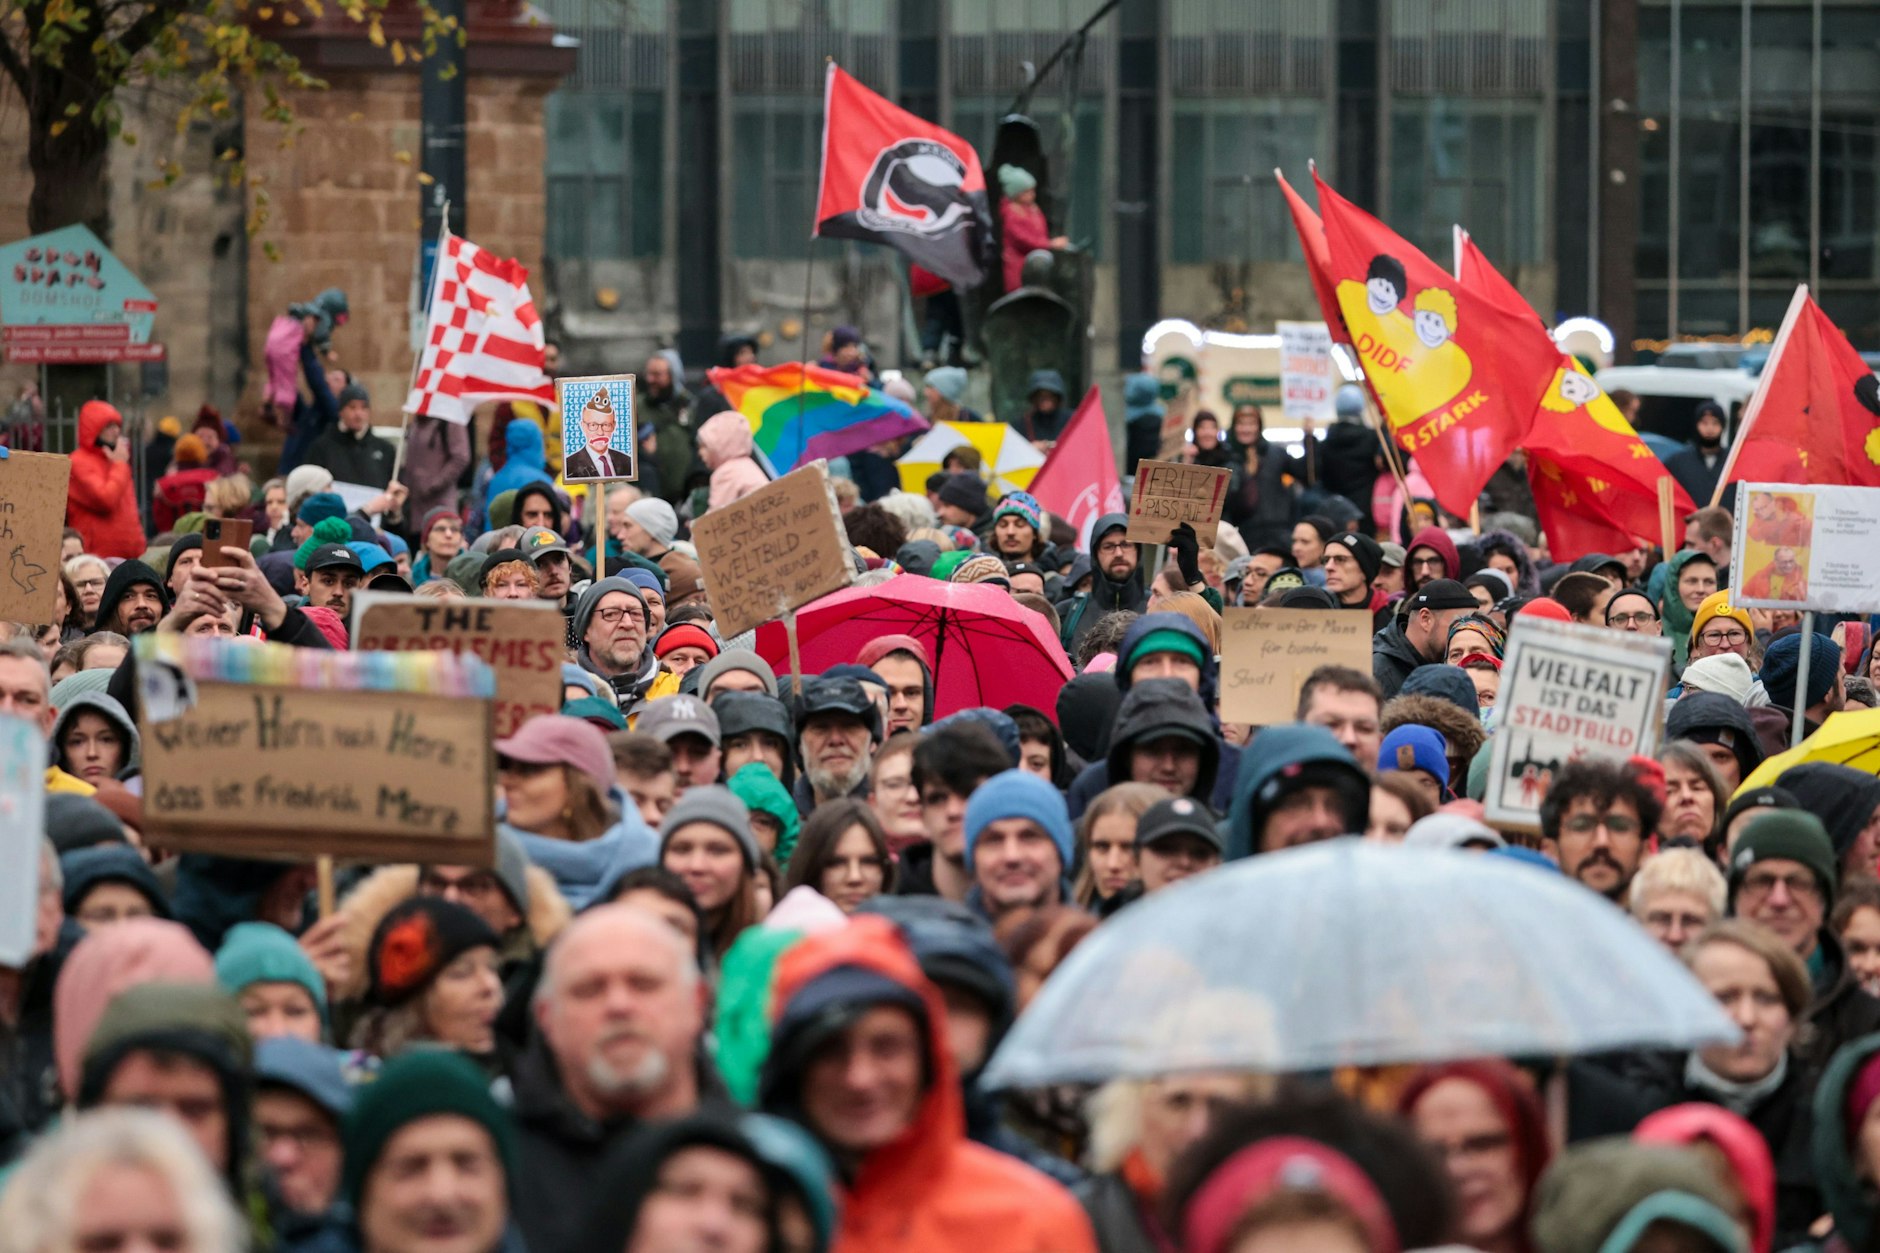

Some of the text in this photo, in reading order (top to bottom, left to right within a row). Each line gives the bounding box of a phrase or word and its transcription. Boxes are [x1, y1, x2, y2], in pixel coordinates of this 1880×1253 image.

[1357, 333, 1414, 374] DIDF
[1418, 389, 1489, 447] STARK
[1148, 467, 1211, 499] FRITZ
[712, 510, 745, 538] HERR
[731, 514, 788, 550] STÖREN
[793, 503, 820, 524] MEIN
[1143, 499, 1205, 521] PASS AUF
[712, 533, 800, 588] WELTBILD
[718, 586, 742, 605] UND
[722, 584, 786, 625] TOCHTER
[414, 606, 496, 632] THE
[1529, 655, 1643, 700] VIELFALT
[1540, 687, 1618, 719] IST DAS
[1514, 704, 1634, 748] STADTBILD
[211, 778, 245, 807] ist
[375, 783, 460, 832] Merz
